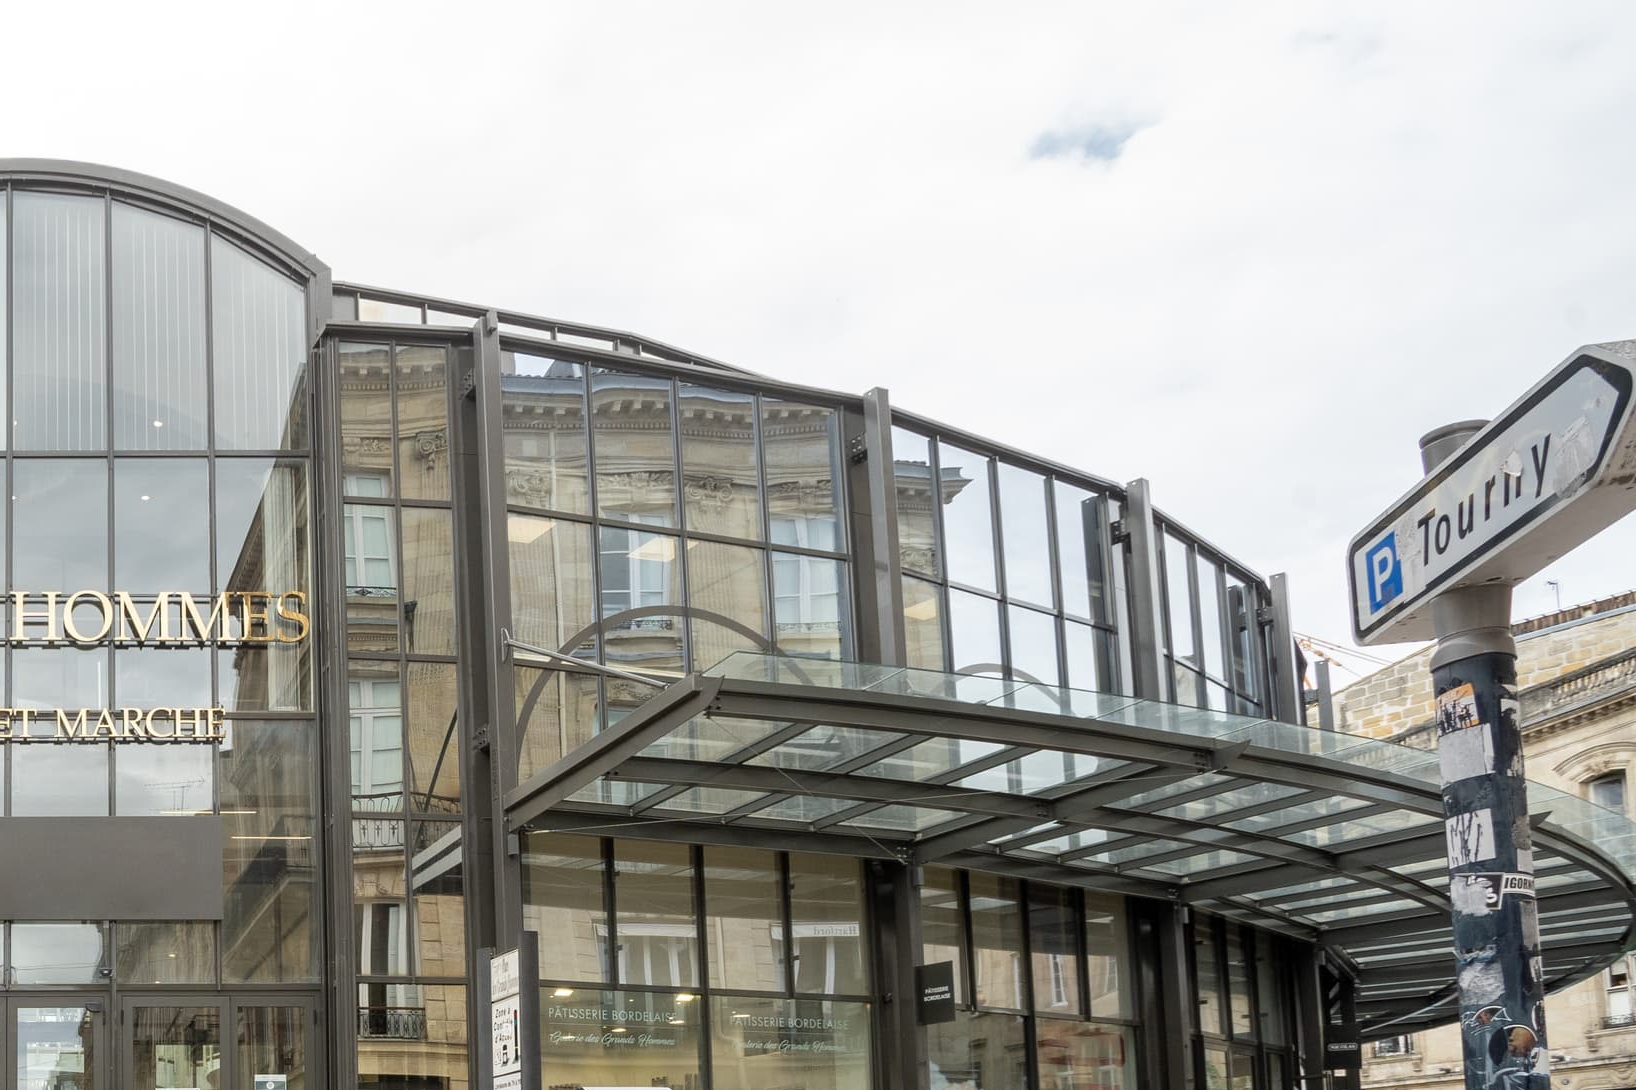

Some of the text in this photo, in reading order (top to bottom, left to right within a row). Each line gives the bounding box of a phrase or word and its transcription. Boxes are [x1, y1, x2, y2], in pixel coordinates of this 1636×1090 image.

[1417, 433, 1552, 566] Tourny
[9, 590, 311, 643] HOMMES
[548, 1006, 678, 1023] PÂTISSERIE BORDELAISE
[788, 1017, 850, 1031] BORDELAISE
[585, 1033, 599, 1044] des
[601, 1032, 635, 1045] Grands
